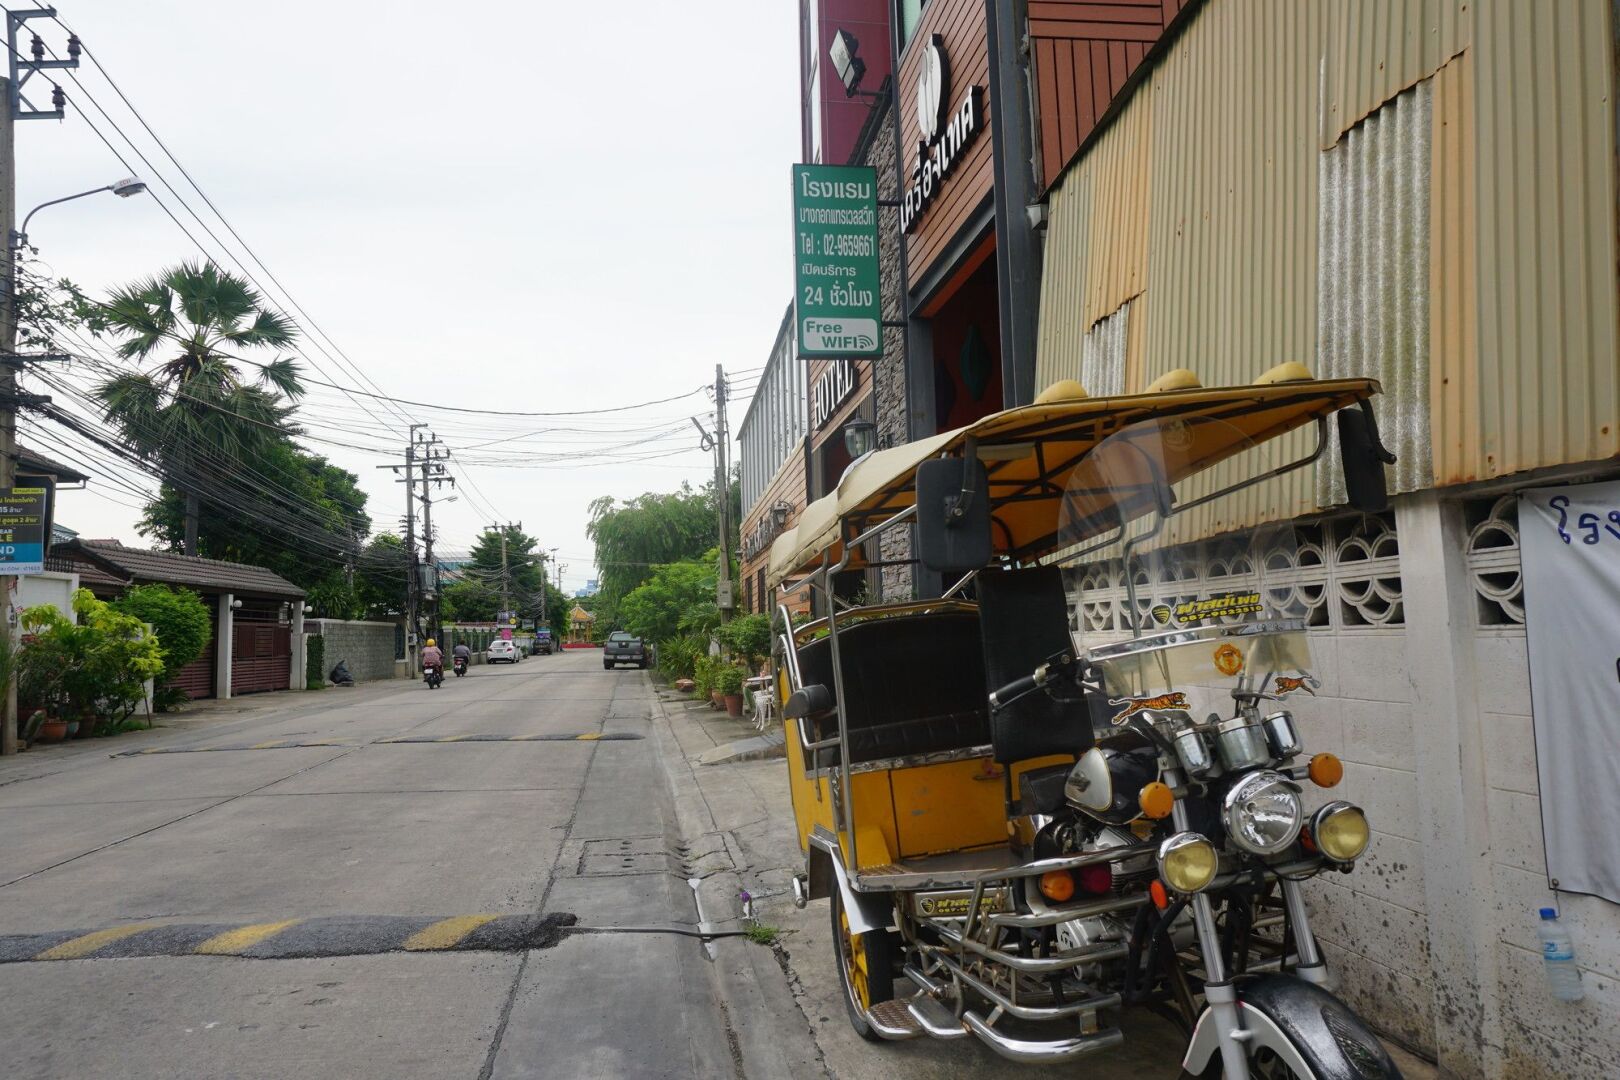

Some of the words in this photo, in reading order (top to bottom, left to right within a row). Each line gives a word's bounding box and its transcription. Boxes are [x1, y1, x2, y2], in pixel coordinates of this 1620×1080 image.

[801, 172, 870, 199] โรงแรม
[800, 232, 814, 255] Tel
[823, 233, 874, 257] 02-9659661
[802, 262, 856, 277] เปิดบริการ
[804, 286, 823, 305] 24
[830, 280, 873, 307] ชั่วโมง
[805, 320, 843, 333] Free
[821, 336, 857, 348] WIFI
[813, 359, 854, 427] HOTEL
